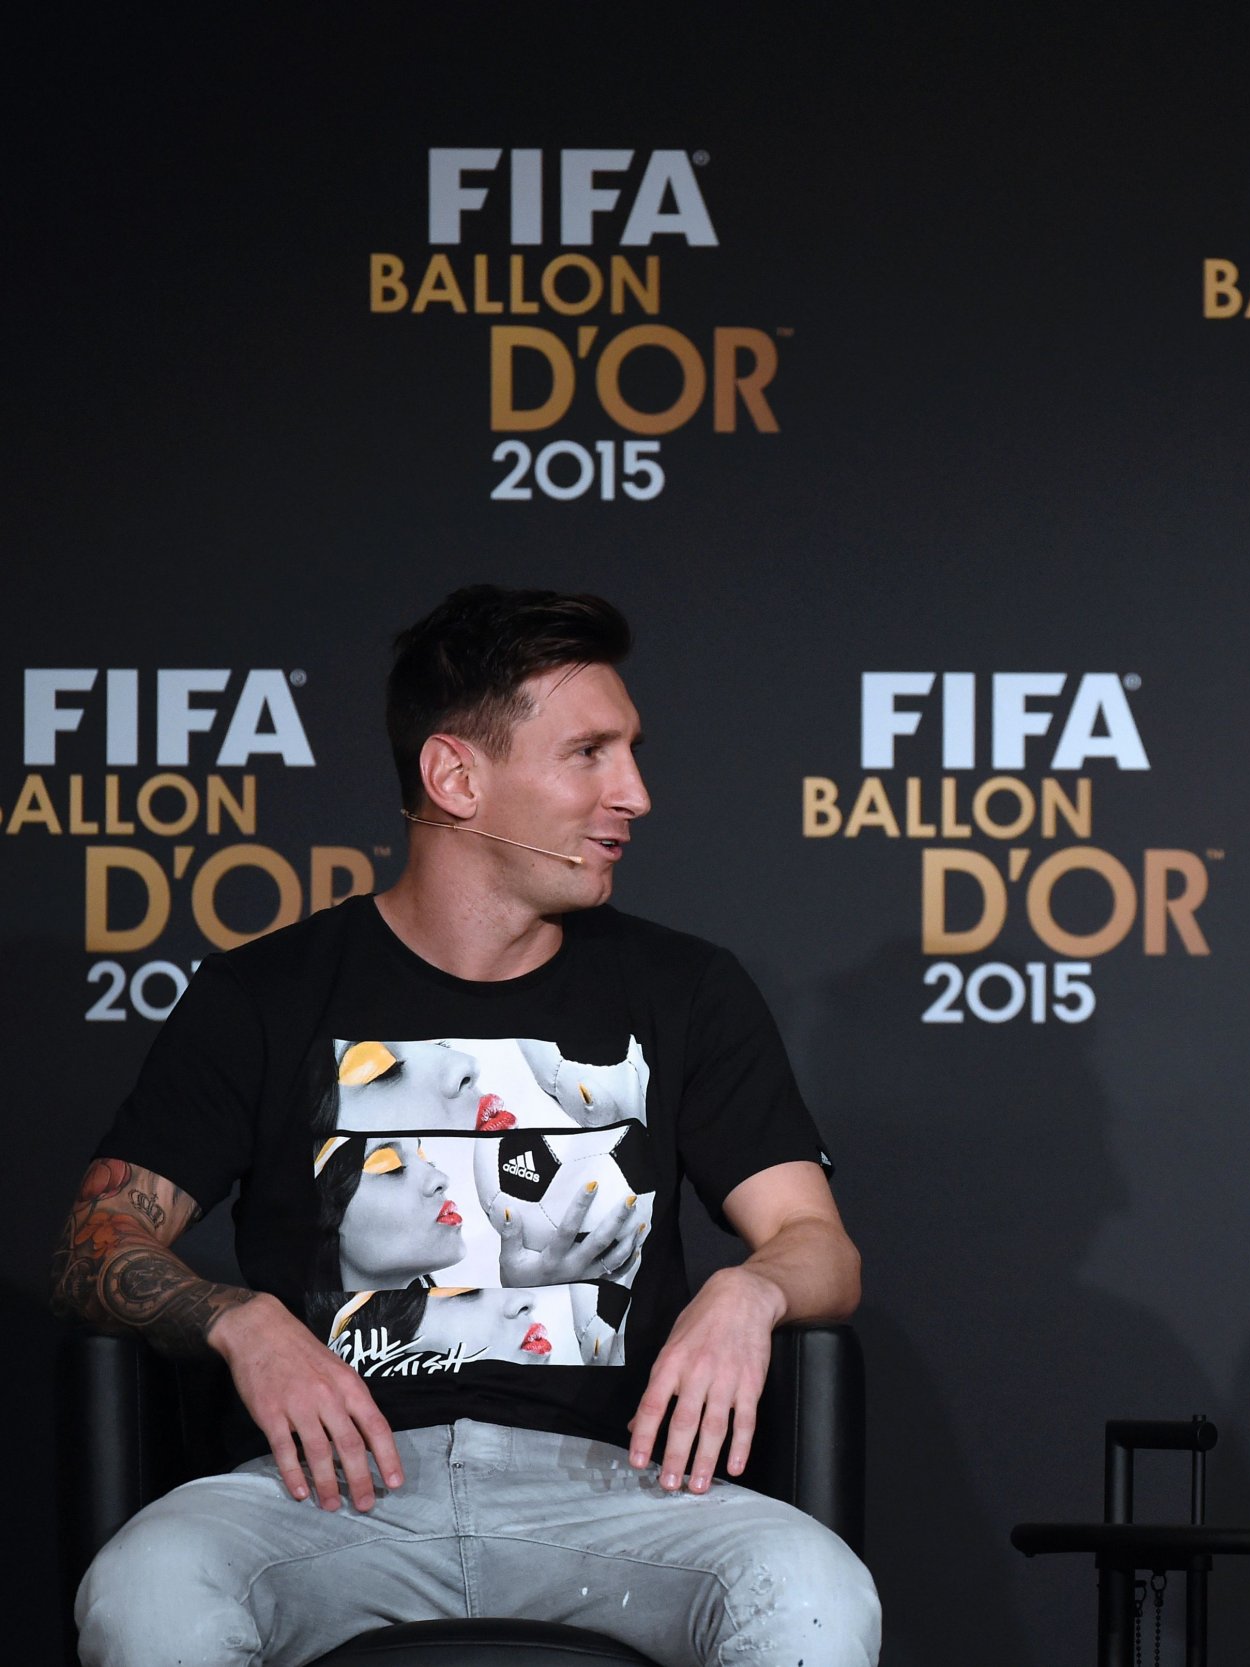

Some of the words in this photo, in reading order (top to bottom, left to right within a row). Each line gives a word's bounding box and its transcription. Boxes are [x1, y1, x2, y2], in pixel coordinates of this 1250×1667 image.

[428, 148, 720, 247] FIFA
[370, 253, 660, 316] BALLON
[490, 324, 779, 435] D'OR
[489, 439, 666, 502] 2015
[23, 668, 317, 768] FIFA
[859, 670, 1152, 772] FIFA
[0, 772, 257, 837] ALLON
[801, 775, 1093, 841] BALLON
[920, 844, 1213, 959] D'OR
[84, 959, 201, 1023] 20
[920, 960, 1097, 1025] 2015
[502, 1163, 540, 1183] adidas
